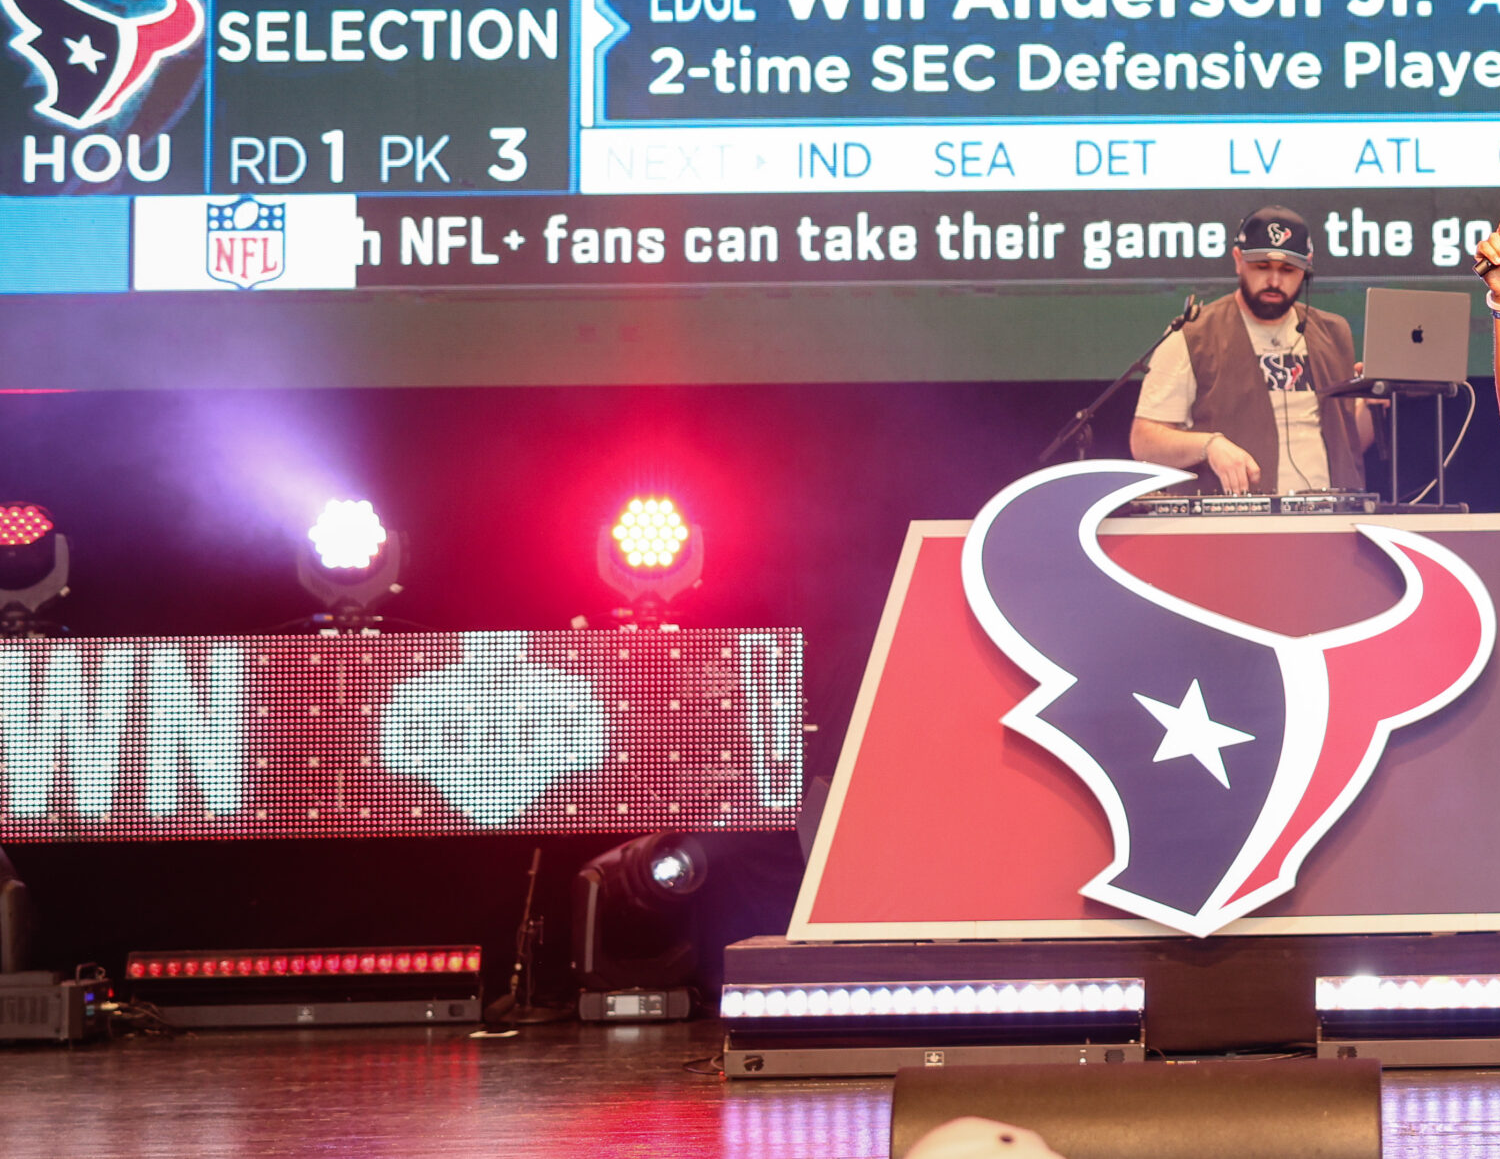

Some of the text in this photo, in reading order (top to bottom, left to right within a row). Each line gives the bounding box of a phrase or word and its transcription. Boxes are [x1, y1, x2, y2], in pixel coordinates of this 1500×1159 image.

[217, 9, 558, 62] SELECTION
[649, 45, 850, 94] 2-time
[871, 45, 996, 92] SEC
[1018, 41, 1322, 92] Defensive
[23, 134, 171, 183] HOU
[230, 127, 527, 183] RD 1 PK 3
[799, 142, 871, 179] IND
[935, 141, 1015, 178] SEA
[1076, 140, 1156, 176] DET
[1230, 138, 1281, 174] LV
[1356, 138, 1435, 173] ATL
[215, 238, 278, 273] NFL
[401, 215, 524, 265] NFL+
[543, 215, 665, 264] fans
[684, 229, 778, 263] can
[797, 212, 917, 261] take
[936, 211, 1064, 260] their
[1084, 221, 1226, 269] game
[1326, 207, 1412, 257] the
